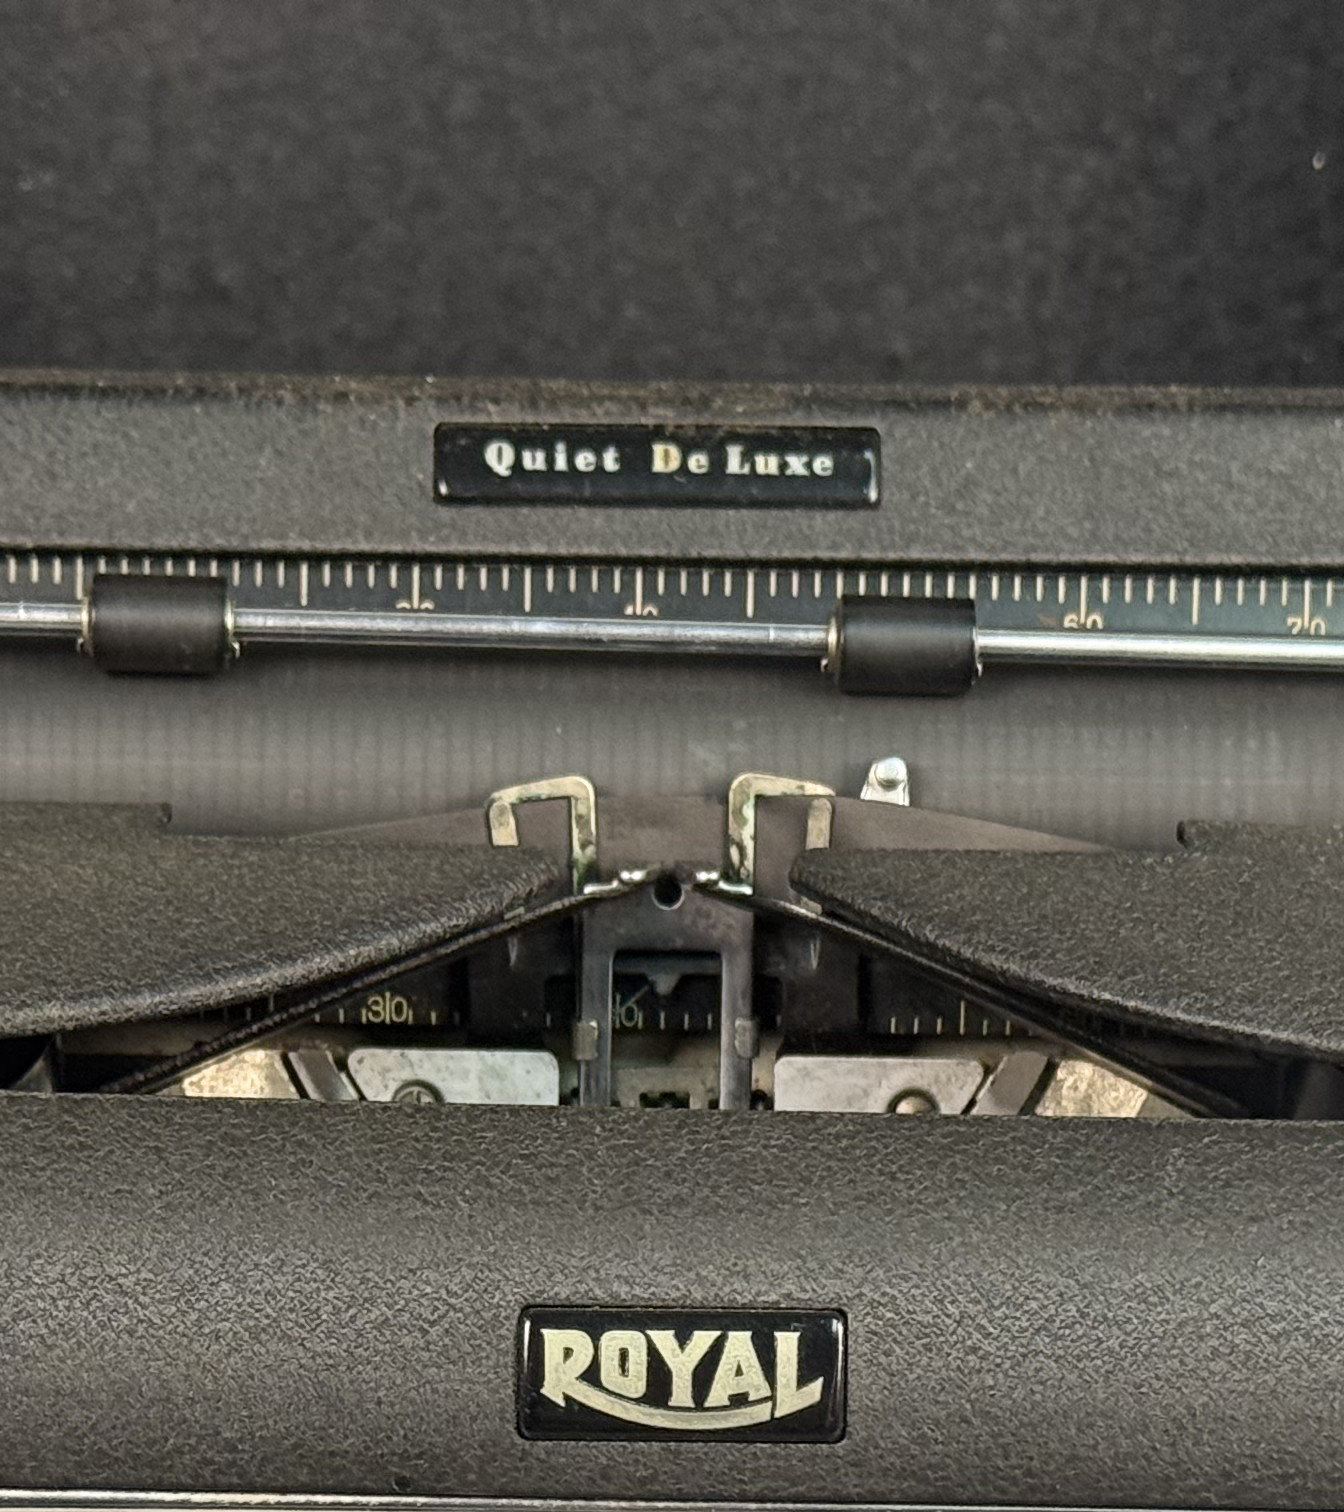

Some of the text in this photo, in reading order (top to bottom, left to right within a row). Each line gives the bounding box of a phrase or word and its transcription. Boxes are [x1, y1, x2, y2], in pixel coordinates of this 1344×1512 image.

[484, 441, 834, 477] Quiet De Luxe
[540, 1328, 824, 1430] ROYAL
